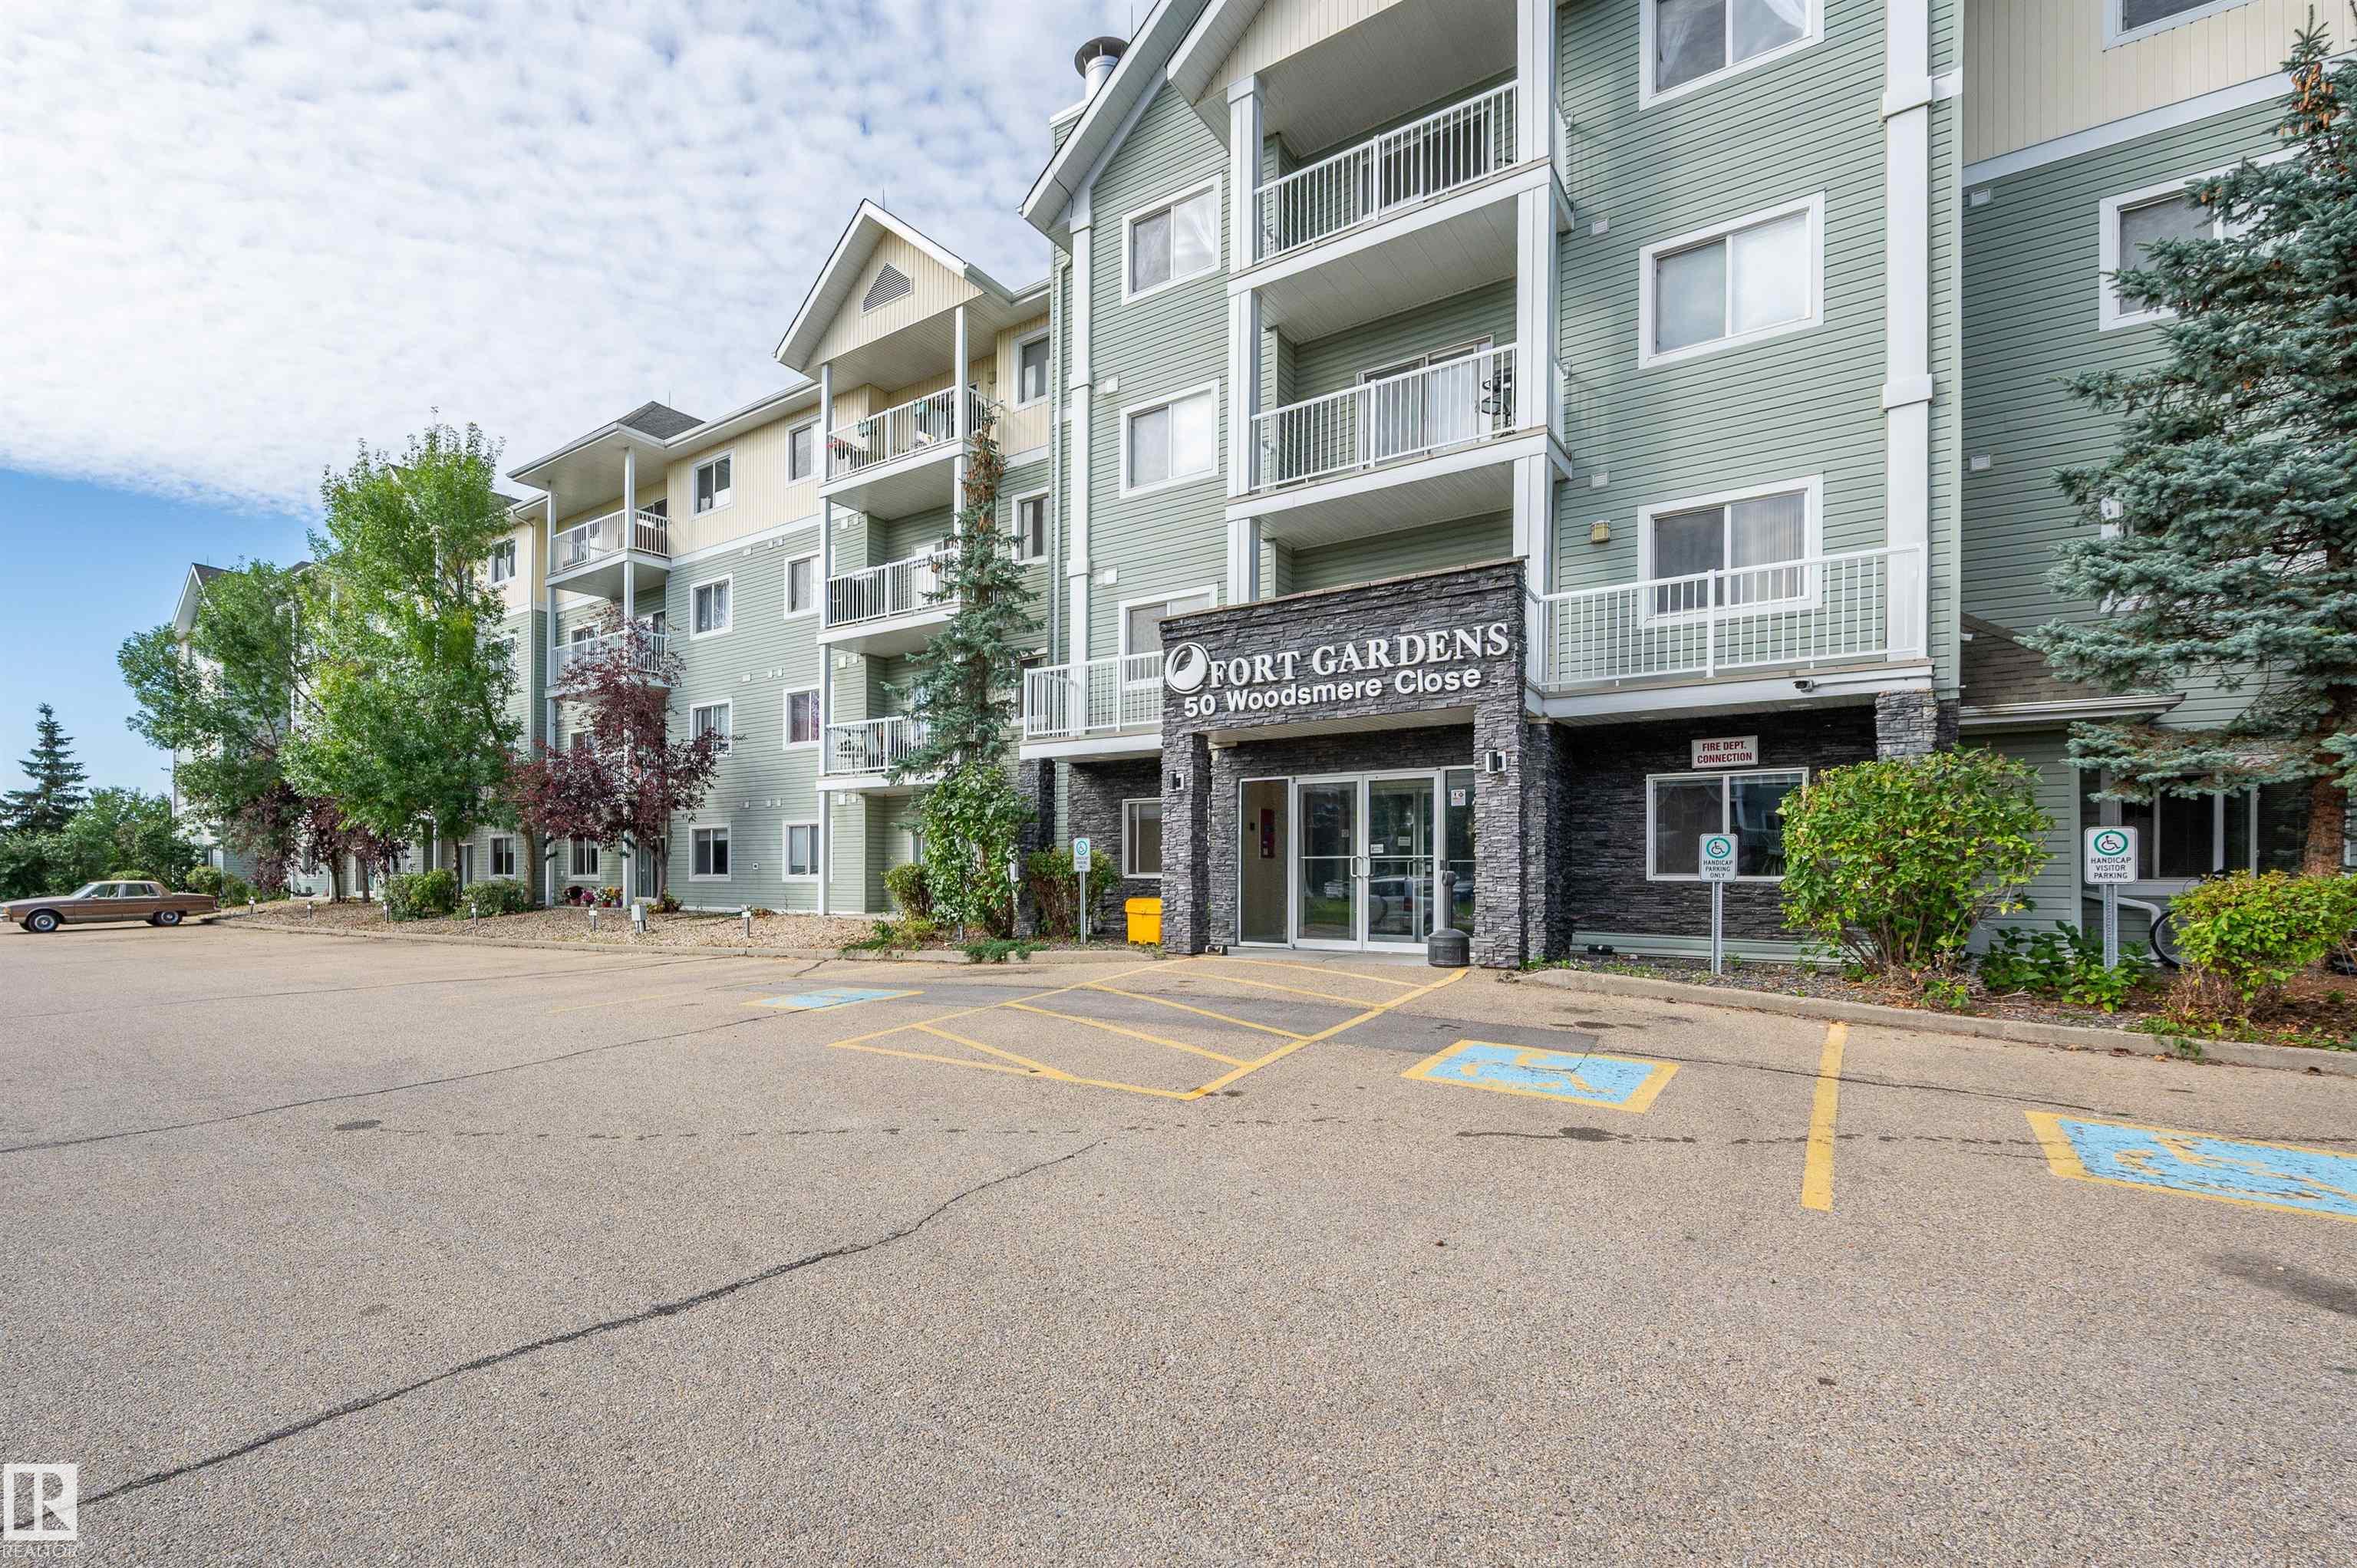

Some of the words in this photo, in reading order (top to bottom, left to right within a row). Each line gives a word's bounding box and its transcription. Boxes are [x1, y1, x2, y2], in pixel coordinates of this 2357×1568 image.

[1208, 650, 1301, 689] FORT
[1312, 622, 1510, 676] GARDENS
[1183, 695, 1216, 718] 50
[1226, 678, 1383, 712] Woodsmere
[1394, 667, 1482, 694] Close
[1697, 752, 1752, 764] CONNECTION
[1703, 742, 1720, 752] FIRE
[1723, 741, 1747, 750] DEPT.
